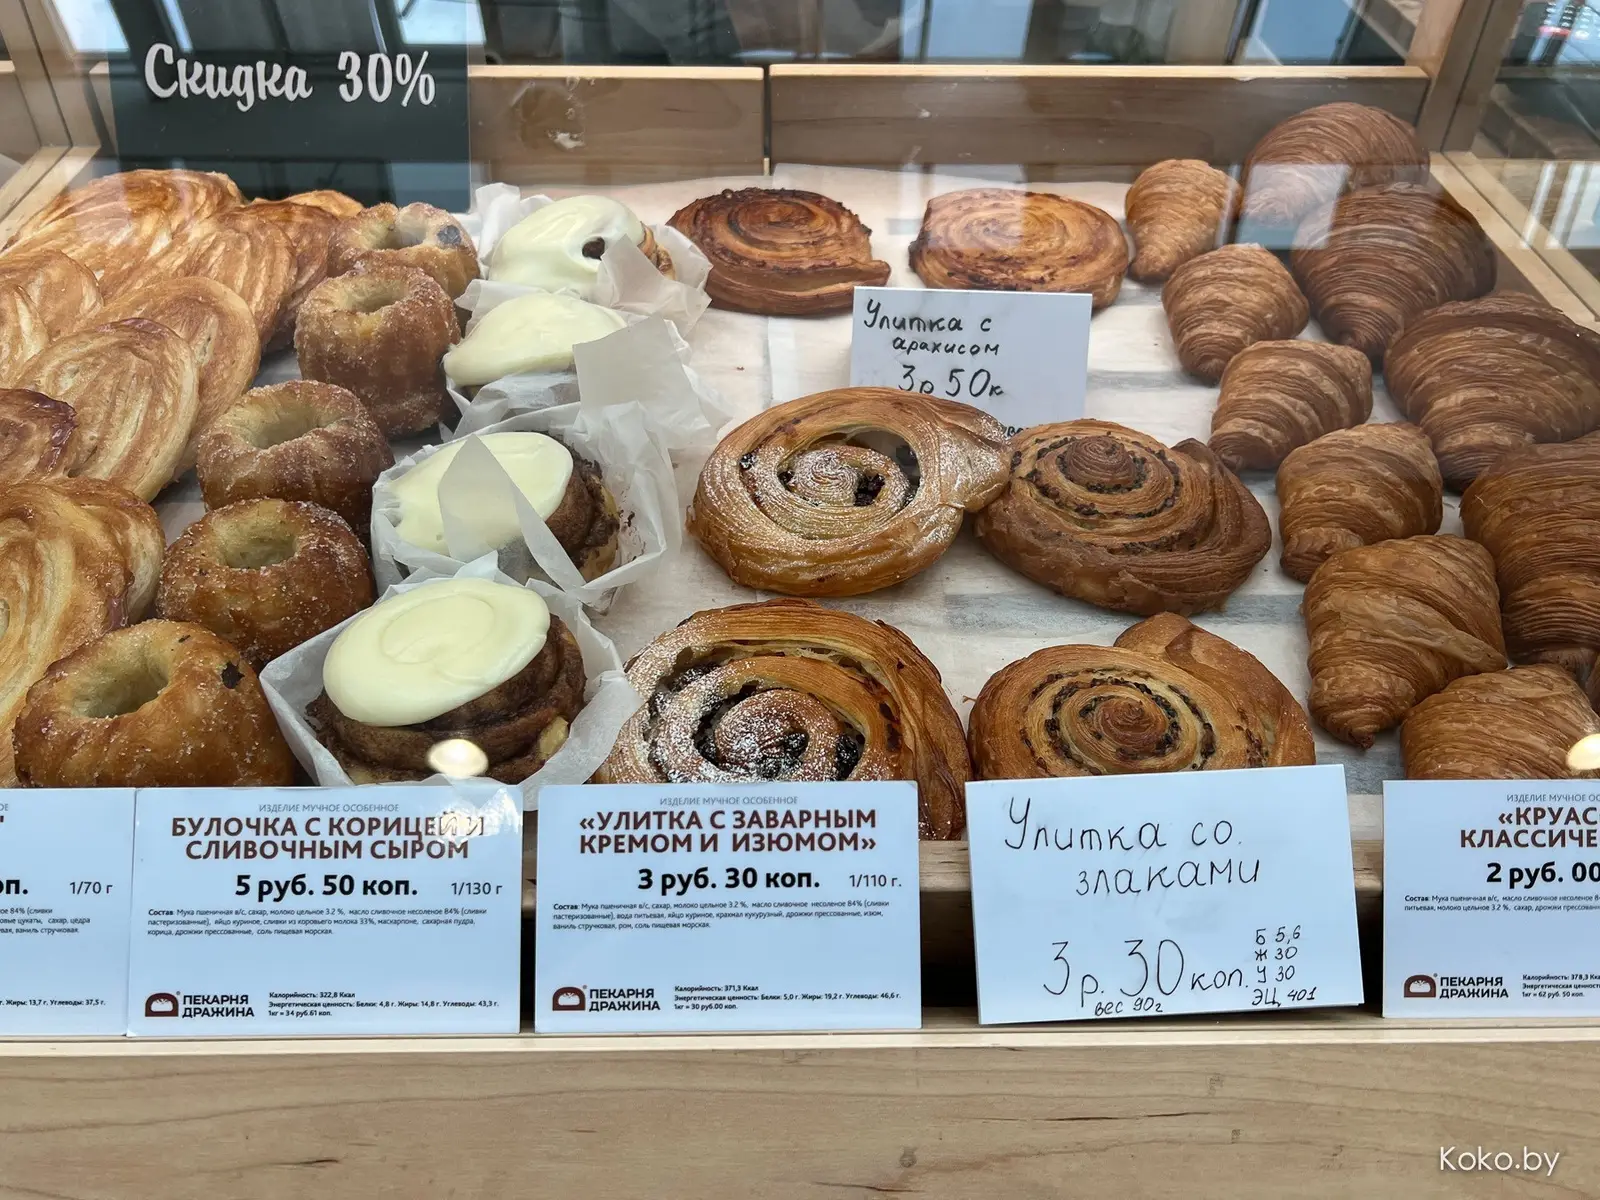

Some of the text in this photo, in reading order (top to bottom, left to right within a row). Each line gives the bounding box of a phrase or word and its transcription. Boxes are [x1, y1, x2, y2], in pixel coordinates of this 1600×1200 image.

[144, 43, 436, 112] Скидка 30%
[864, 298, 992, 332] Улитка с
[892, 336, 1000, 356] арахисом
[660, 798, 700, 806] ИЗДЕЛИЕ
[703, 797, 740, 805] МУЧНОЕ
[1507, 794, 1547, 802] ИЗДЕЛИЕ
[259, 804, 399, 812] ИЗДЕЛИЕ МУЧНОЕ ОСОБЕННОЕ
[172, 818, 298, 836] БУЛОЧКА
[305, 818, 321, 836] С
[329, 811, 457, 840] КОРИЦЕЙ
[579, 809, 876, 830] «УЛИТКА С ЗАВАРНЫМ
[1005, 797, 1167, 850] Улитка
[186, 840, 468, 859] СЛИВОЧНЫМ СЫРОМ
[580, 833, 876, 853] КРЕМОМ И ИЗЮМОМ»
[638, 868, 653, 889] 3
[661, 867, 717, 896] руб.
[725, 867, 758, 888] 30
[765, 872, 820, 888] коп.
[849, 874, 887, 888] 1/110
[1076, 859, 1261, 896] злаками
[1487, 863, 1502, 882] 2
[1509, 861, 1564, 889] руб.
[70, 882, 102, 895] 1/70
[236, 874, 251, 895] 5
[258, 874, 314, 902] руб.
[322, 874, 355, 895] 50
[363, 880, 418, 895] коп.
[451, 882, 491, 895] 1/130
[177, 909, 194, 917] Мука
[1256, 925, 1301, 945] Б 5,6
[1255, 946, 1298, 961] Ж 30
[1043, 941, 1070, 996] 3
[1120, 939, 1186, 997] 30
[1191, 968, 1249, 992] коп.
[1257, 965, 1295, 983] У 30
[1440, 977, 1503, 986] ПЕКАРНЯ
[183, 994, 249, 1005] ПЕКАРНЯ
[590, 988, 654, 999] ПЕКАРНЯ
[1252, 987, 1317, 1007] ЭЦ 401
[1439, 989, 1509, 999] ДРАЖИНА
[182, 1007, 255, 1018] ДРАЖИНА
[589, 1001, 661, 1012] ДРАЖИНА
